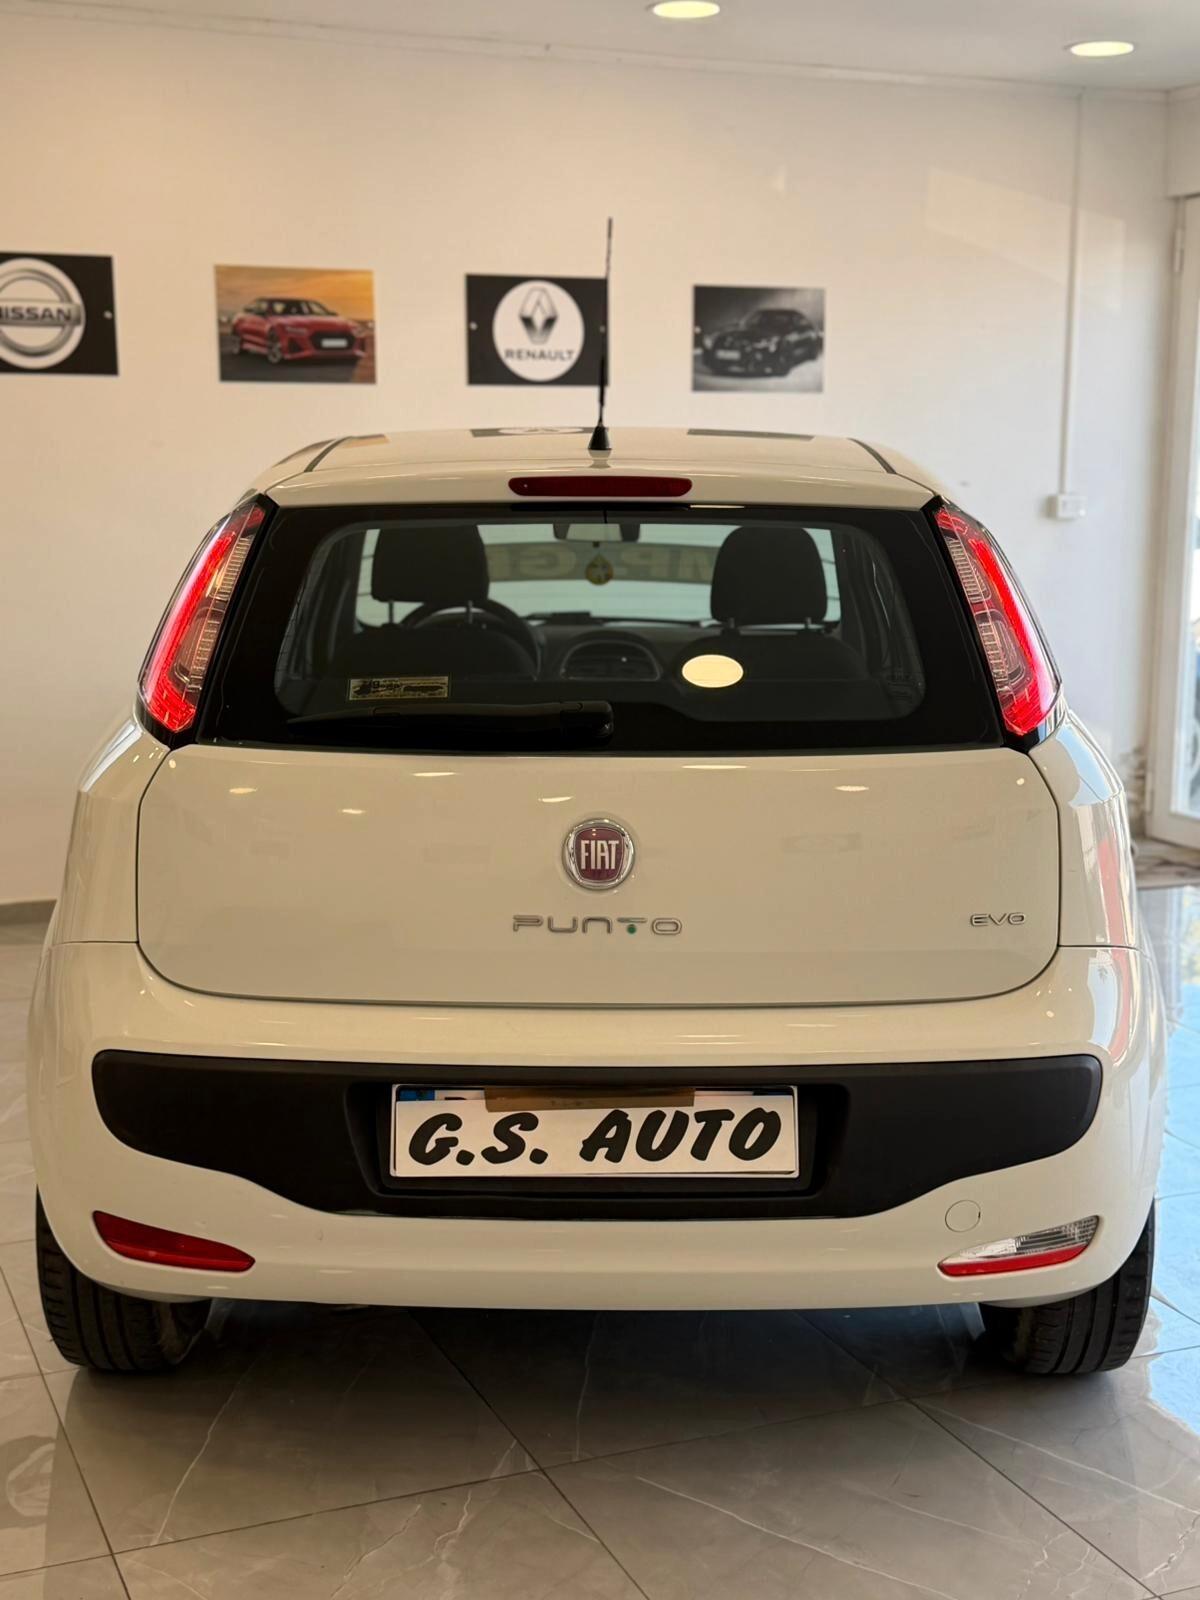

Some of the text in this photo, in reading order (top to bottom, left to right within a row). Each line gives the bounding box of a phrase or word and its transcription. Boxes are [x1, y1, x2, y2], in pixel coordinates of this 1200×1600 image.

[0, 305, 72, 321] ISSAN
[504, 348, 574, 361] RENAULT
[580, 840, 620, 870] FIAT
[512, 914, 683, 936] PUNTO
[970, 912, 1026, 927] EVO
[579, 1106, 782, 1164] AUTO
